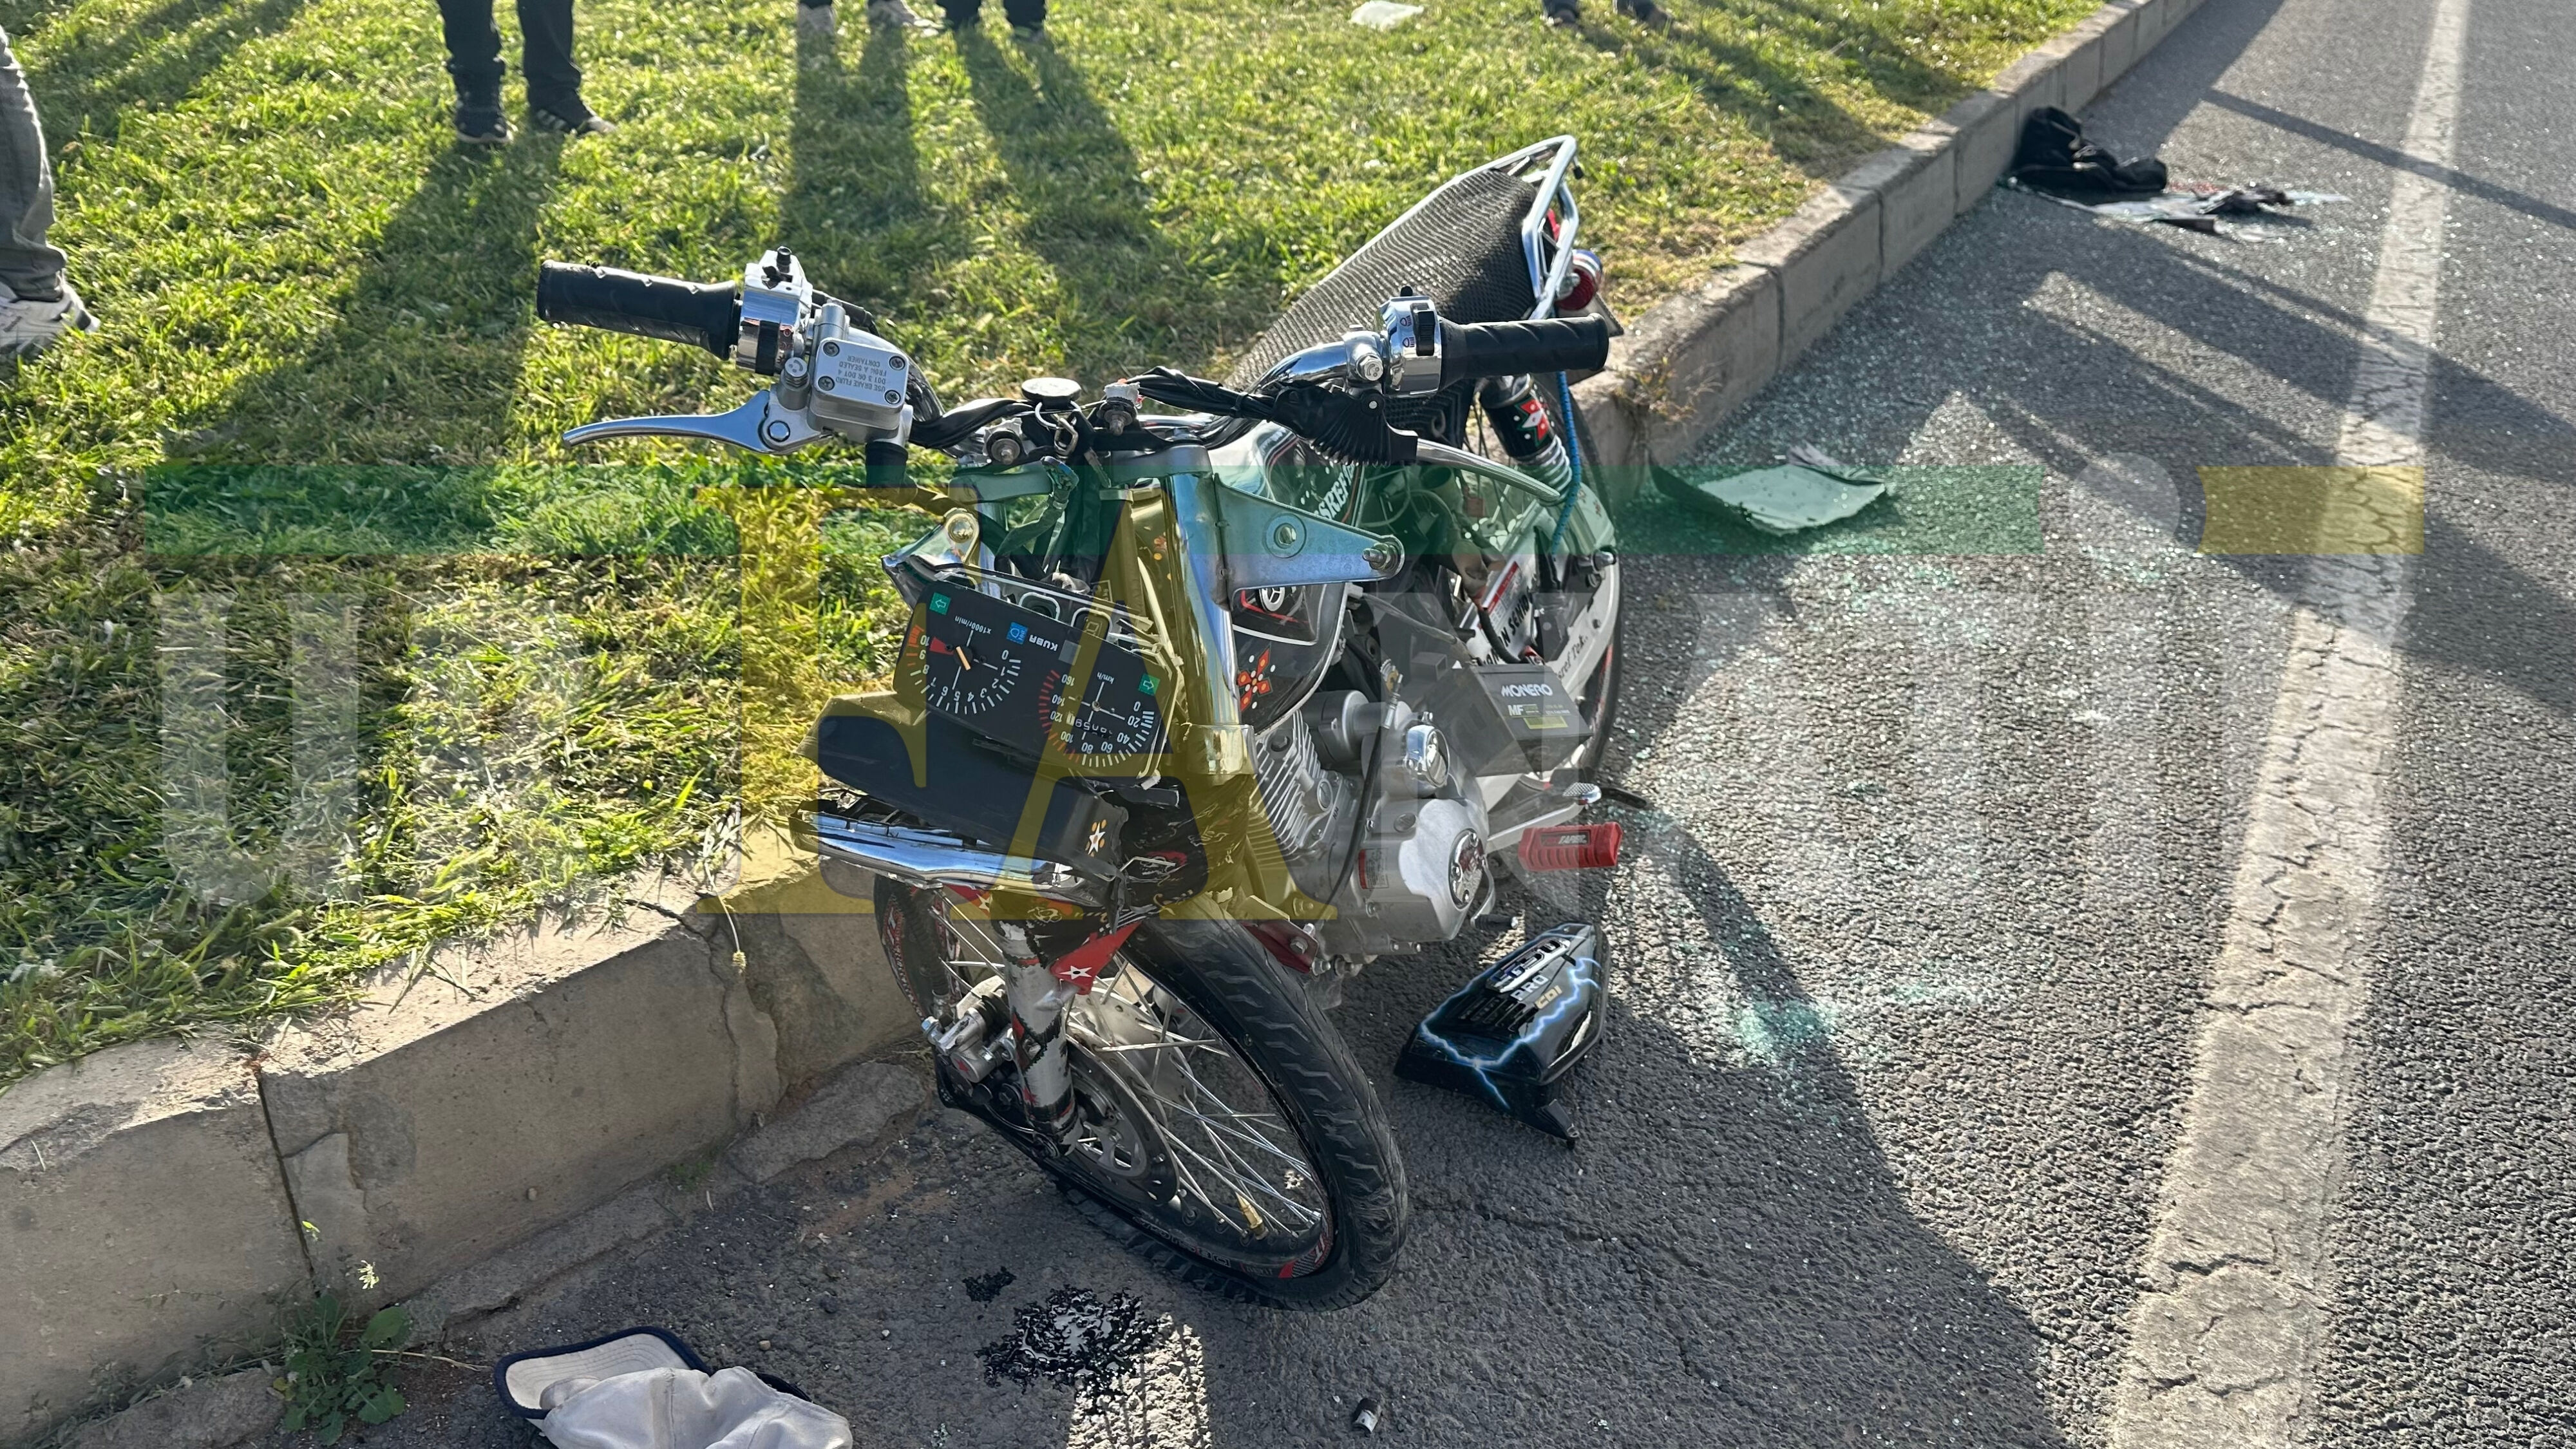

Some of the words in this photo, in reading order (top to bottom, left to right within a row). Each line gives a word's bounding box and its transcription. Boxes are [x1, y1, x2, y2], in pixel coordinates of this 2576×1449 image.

[838, 361, 862, 371] SEALED
[870, 368, 887, 376] FROM
[853, 380, 872, 390] BRAKE
[920, 635, 930, 647] 10
[1028, 634, 1058, 652] KUBA
[920, 650, 926, 659] 9
[1002, 650, 1009, 659] 0
[923, 665, 929, 674] 8
[1001, 667, 1005, 676] 1
[930, 677, 936, 687] 7
[992, 678, 999, 688] 2
[1061, 674, 1075, 686] 160
[1096, 672, 1115, 684] km/h
[942, 686, 948, 696] 6
[954, 691, 960, 701] 5
[980, 688, 987, 697] 3
[1501, 684, 1553, 697] MONERO
[968, 692, 974, 702] 4
[1052, 694, 1065, 706] 140
[1133, 701, 1141, 712] 0
[1508, 704, 1524, 715] MF
[1050, 710, 1063, 722] 120
[1128, 715, 1141, 728] 20
[1060, 731, 1074, 743] 100
[1117, 732, 1130, 744] 40
[1081, 742, 1094, 754] 80
[1101, 741, 1113, 753] 60
[1510, 974, 1549, 1001] PRO
[1535, 985, 1563, 1010] CDI
